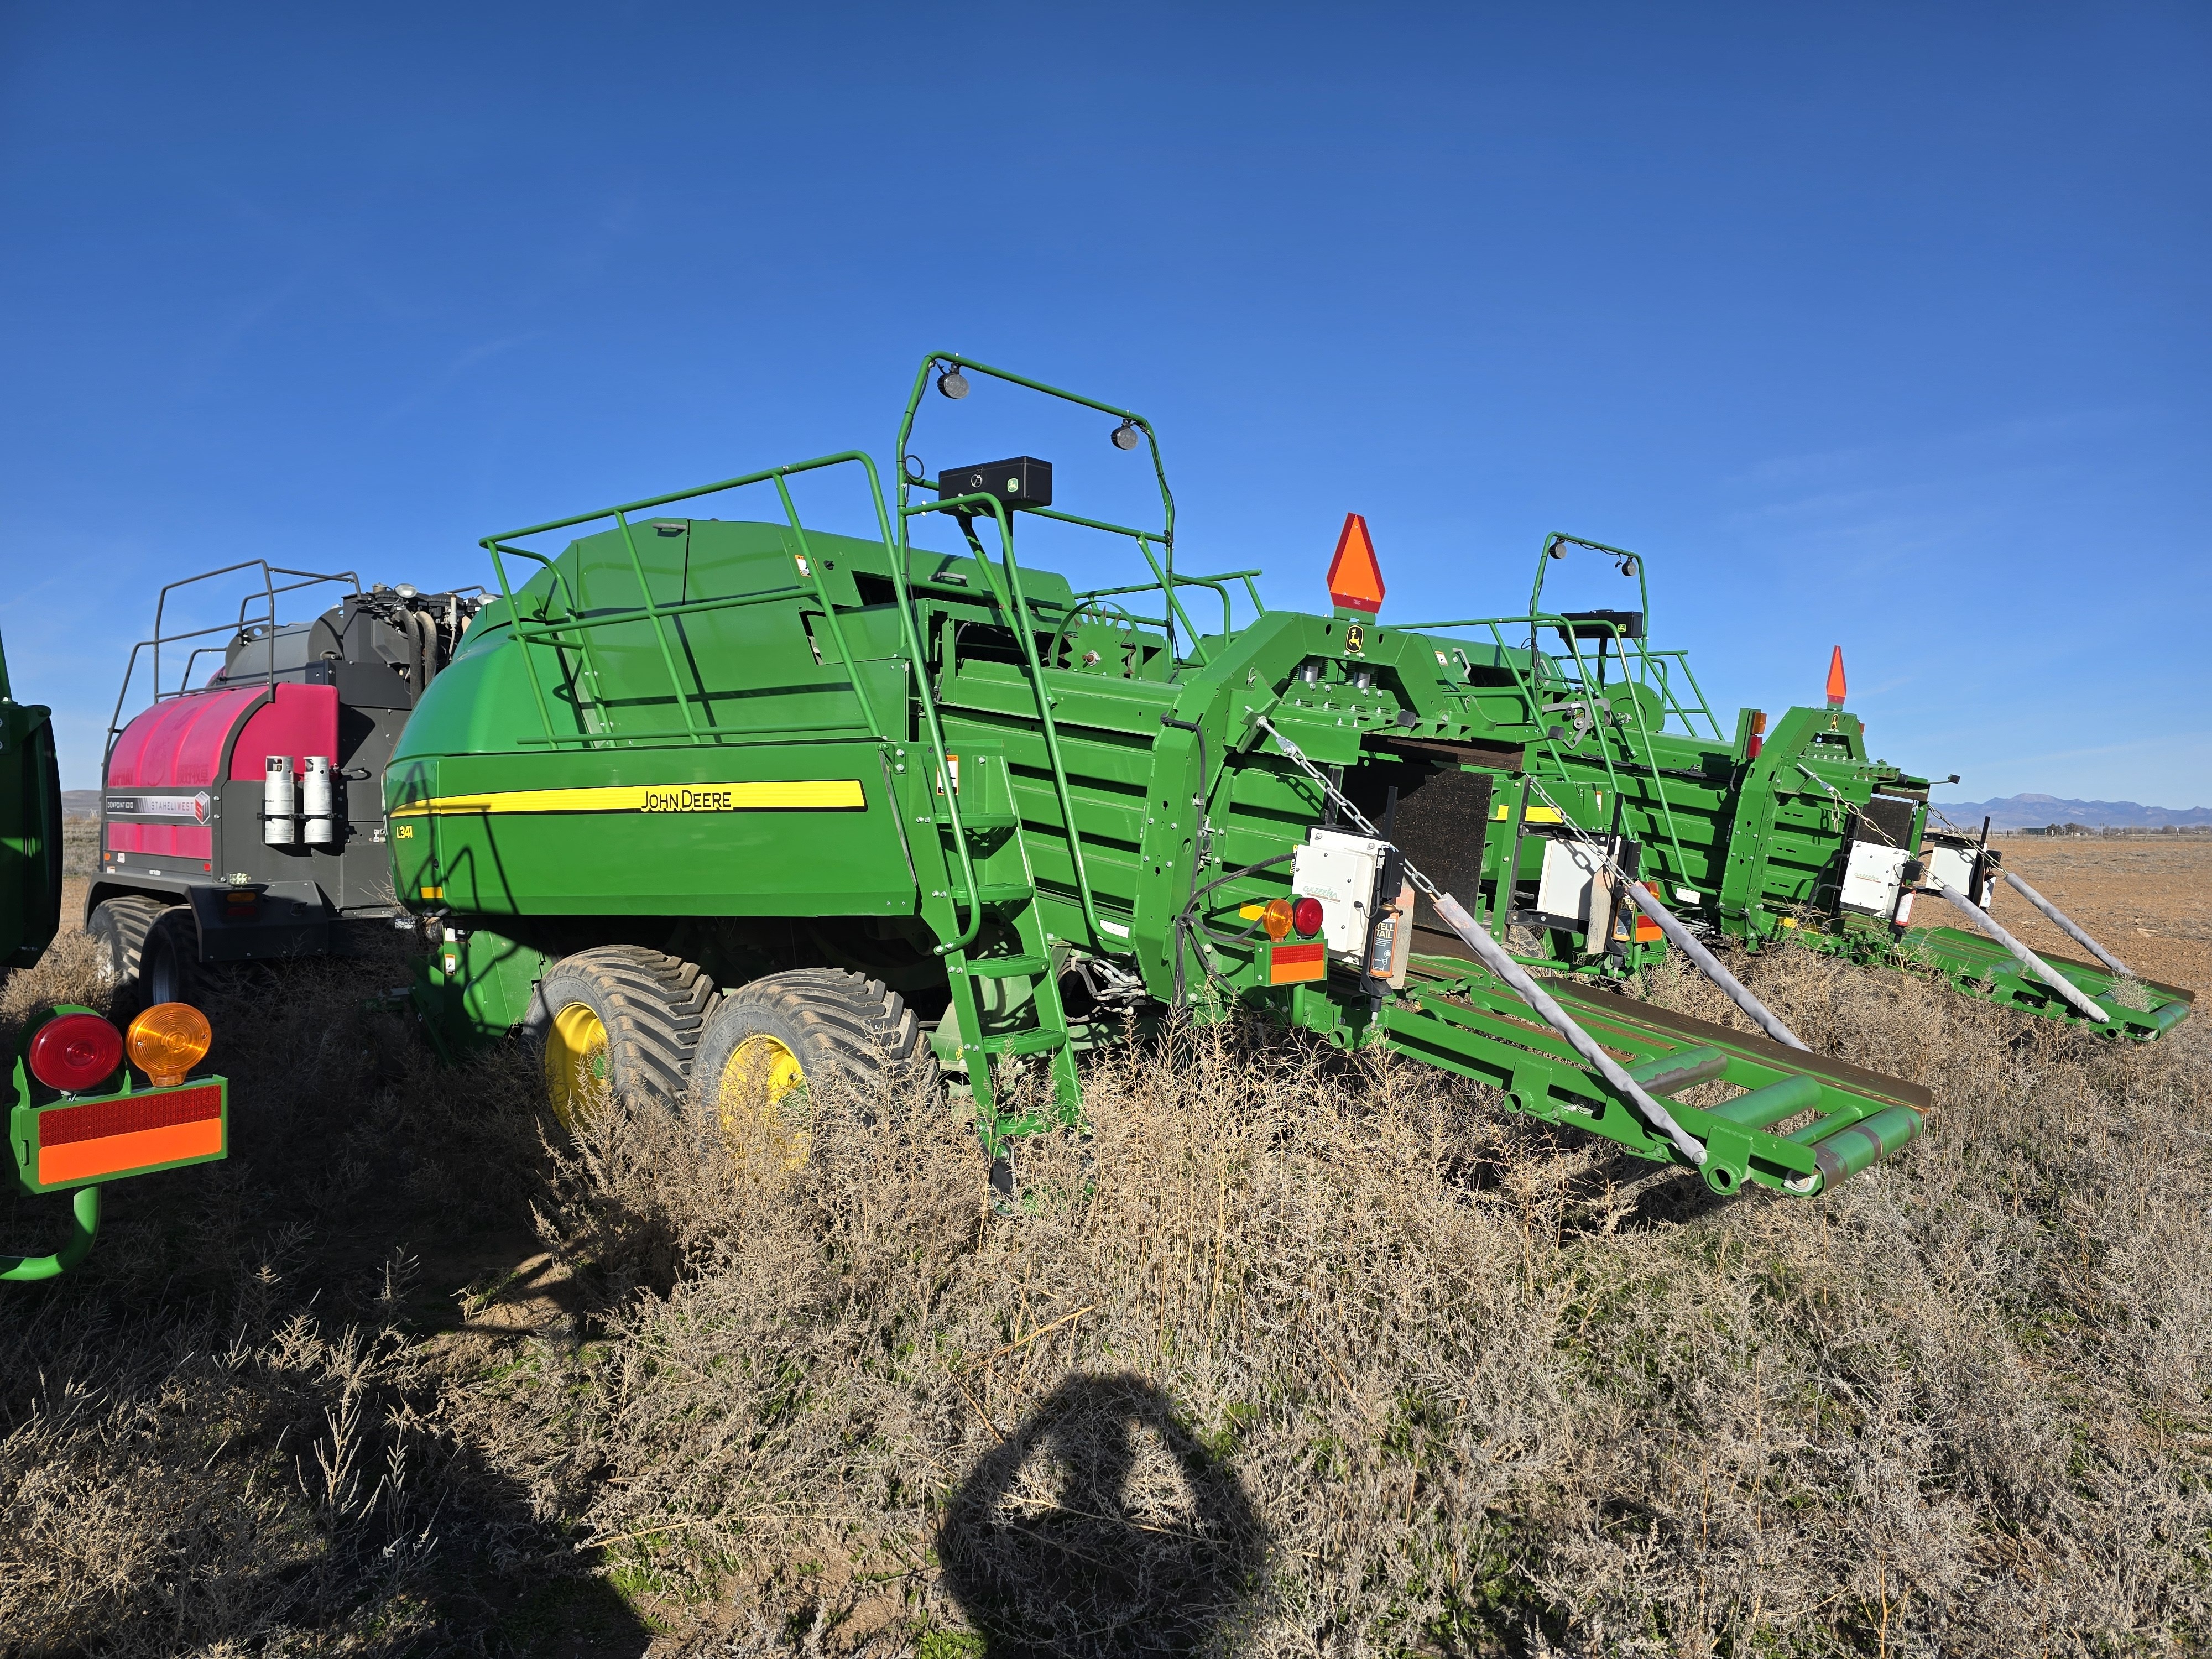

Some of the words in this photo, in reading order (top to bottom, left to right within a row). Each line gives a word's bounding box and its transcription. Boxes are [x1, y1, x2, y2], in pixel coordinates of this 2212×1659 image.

[641, 791, 679, 809] JOHN
[681, 790, 732, 808] DEERE
[396, 825, 413, 839] L341
[1377, 922, 1394, 931] TELL
[1376, 929, 1392, 938] TAIL
